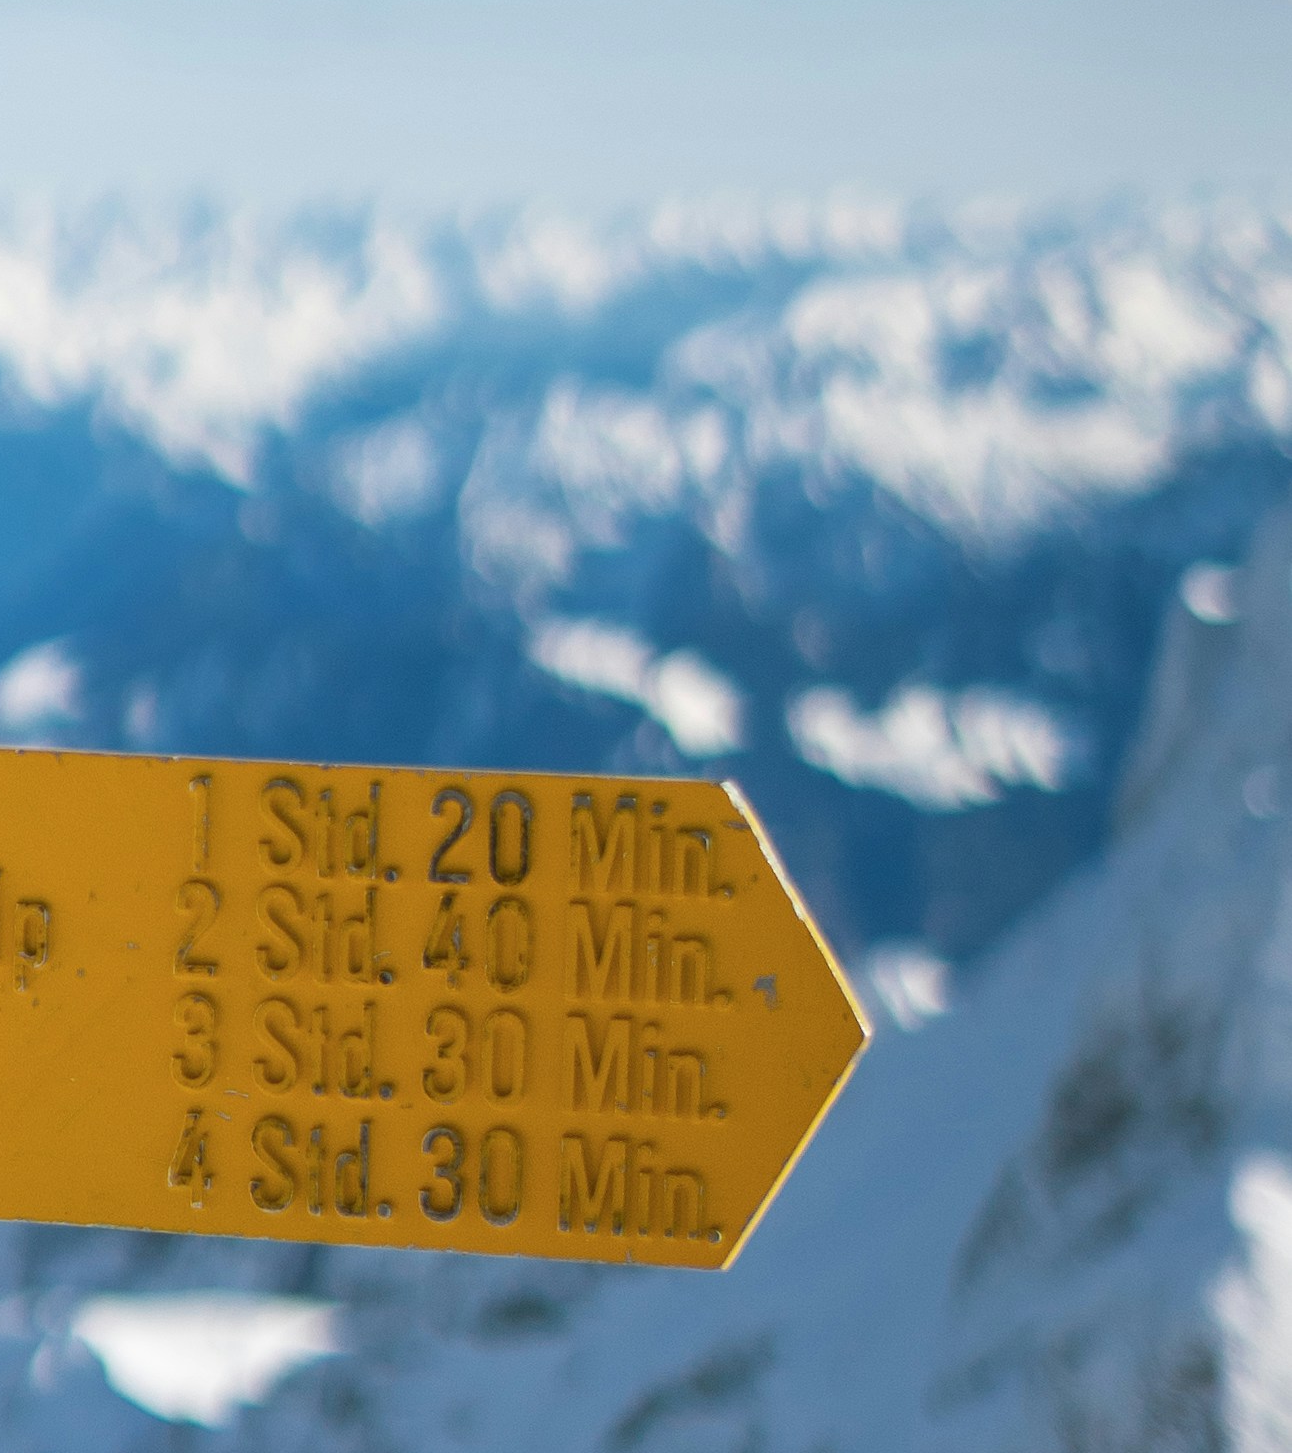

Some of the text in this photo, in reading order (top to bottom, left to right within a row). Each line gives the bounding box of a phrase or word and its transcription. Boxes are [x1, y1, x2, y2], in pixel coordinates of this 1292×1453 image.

[188, 775, 213, 873] 1
[256, 777, 398, 883] Std.
[427, 789, 533, 885] 20
[569, 793, 733, 901] Min.
[173, 880, 218, 978] 2
[254, 886, 395, 986] Std.
[422, 893, 529, 993] 40
[565, 899, 733, 1005] Min.
[170, 993, 216, 1089] 3
[251, 998, 394, 1101] Std.
[421, 1007, 528, 1107] 30
[563, 1012, 727, 1121] Min.
[167, 1110, 212, 1209] 4
[249, 1115, 392, 1219] Std.
[418, 1126, 522, 1226] 30
[558, 1133, 722, 1245] Min.
